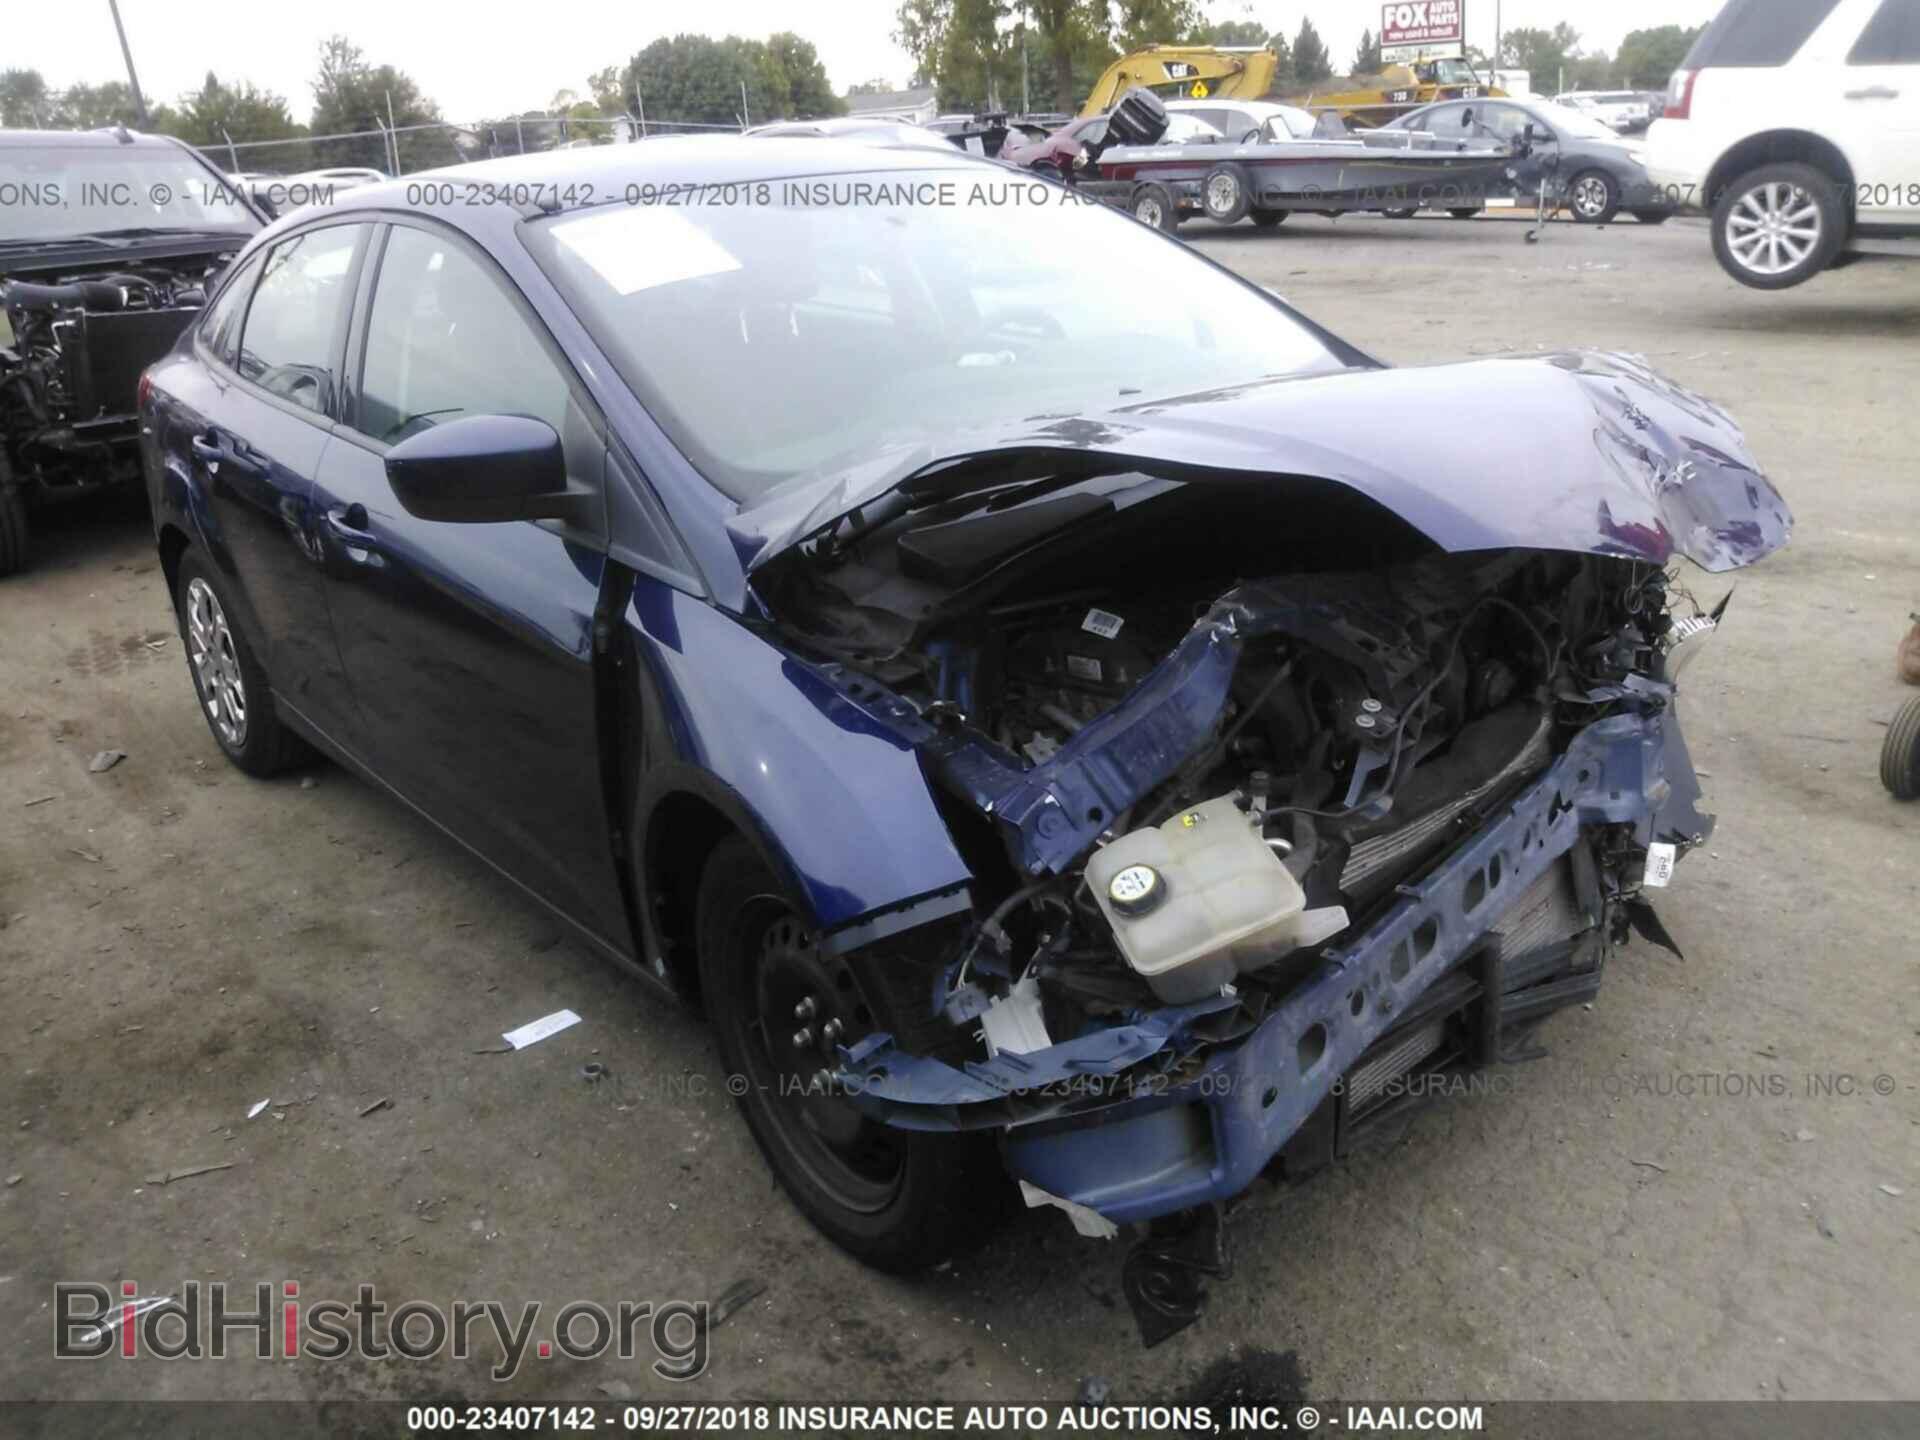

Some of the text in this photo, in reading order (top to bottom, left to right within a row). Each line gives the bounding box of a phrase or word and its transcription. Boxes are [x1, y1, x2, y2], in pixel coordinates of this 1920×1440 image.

[1385, 1, 1457, 30] FOX AUTO
[1430, 12, 1458, 26] PARTS
[1171, 63, 1188, 77] CAT
